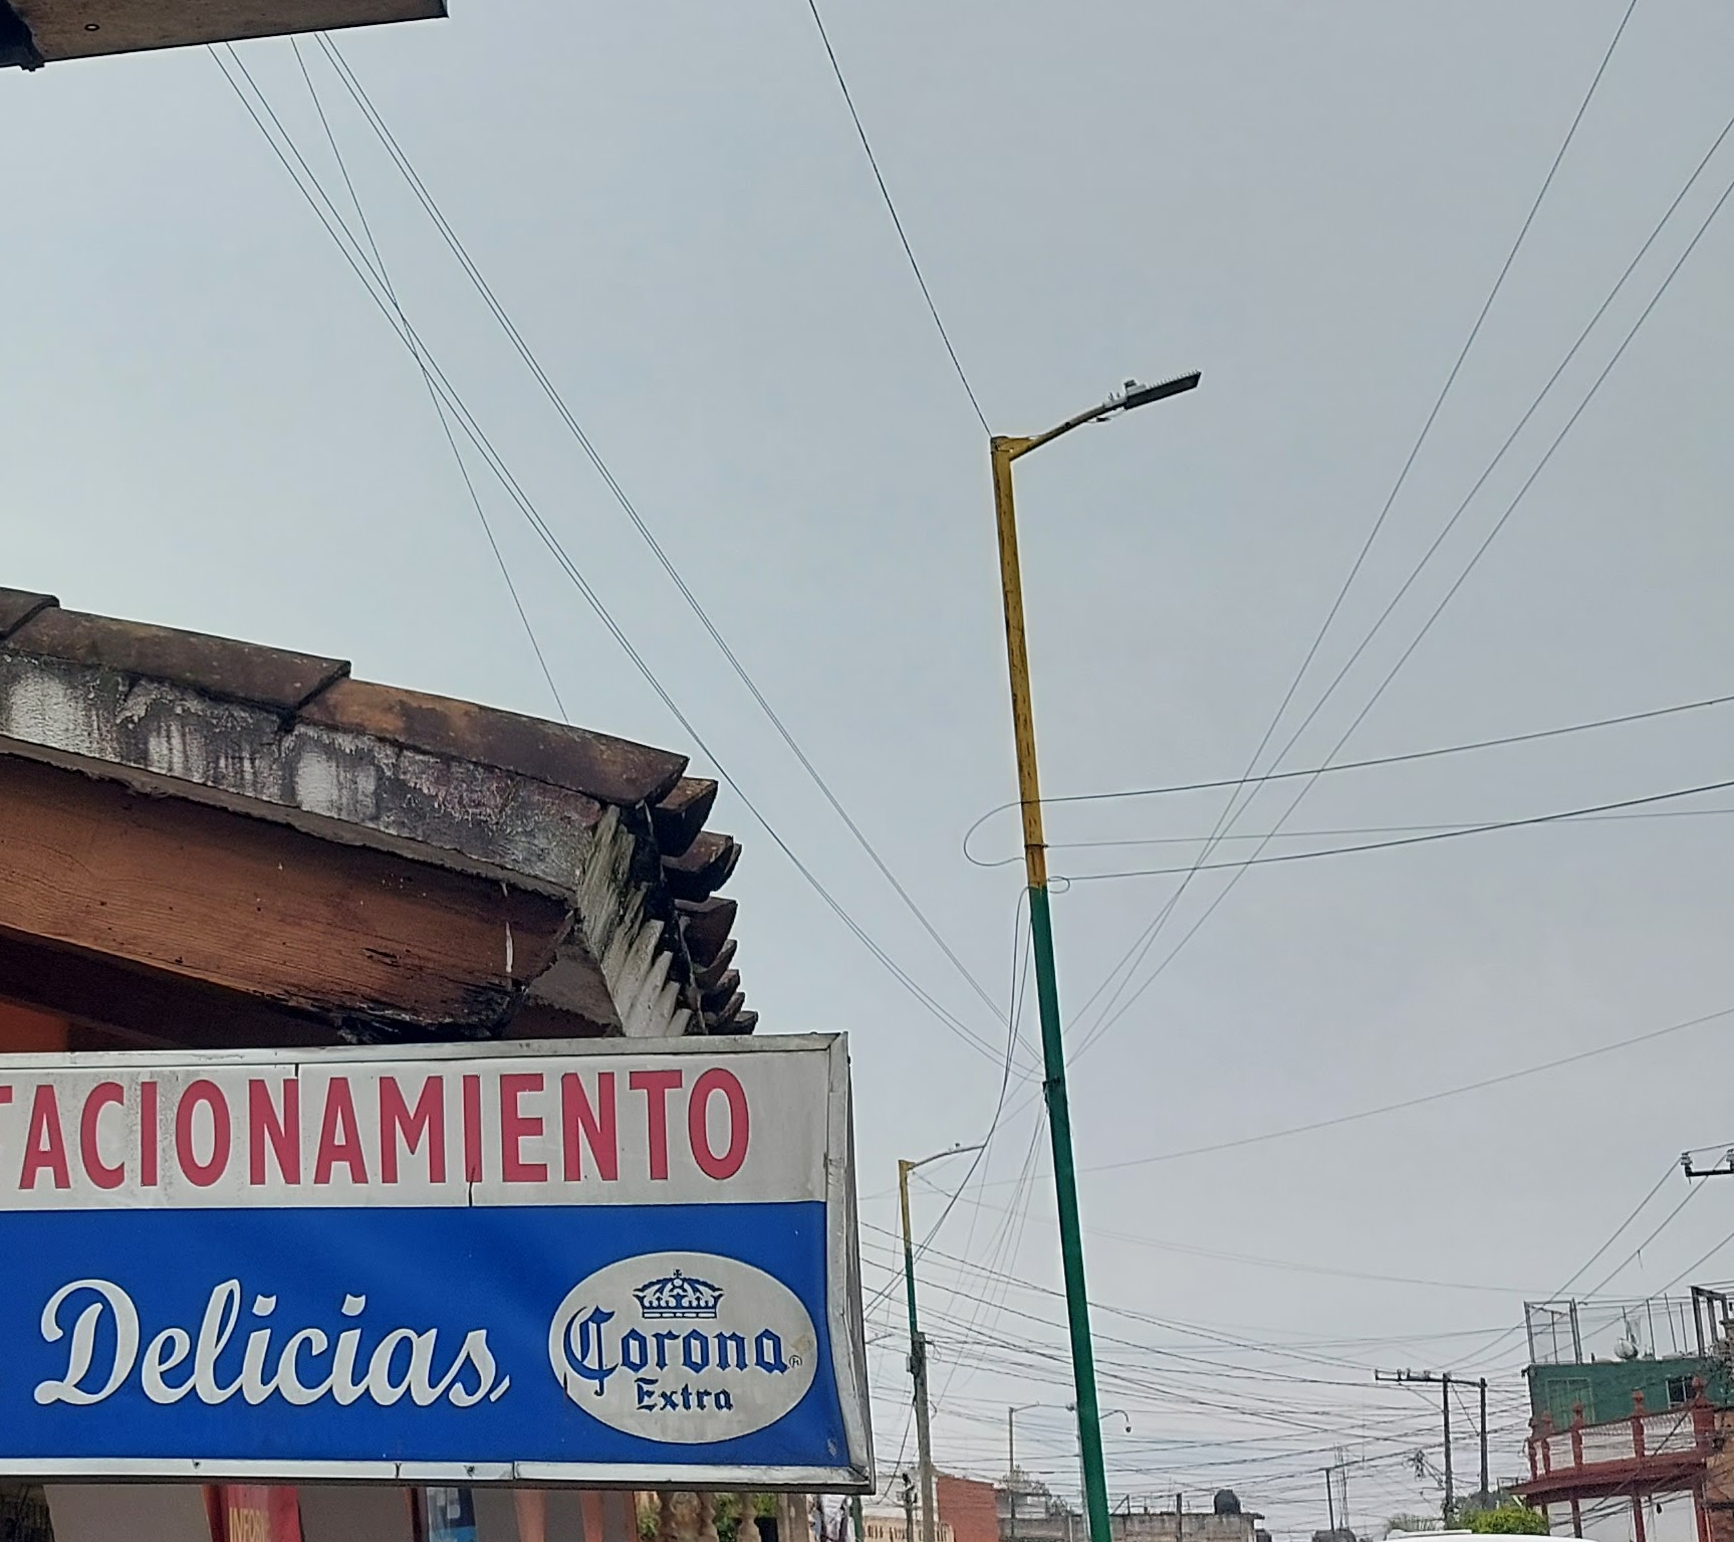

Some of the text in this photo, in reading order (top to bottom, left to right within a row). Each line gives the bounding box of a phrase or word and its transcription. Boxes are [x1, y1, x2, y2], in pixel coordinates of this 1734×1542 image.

[33, 1277, 512, 1409] Delicias
[563, 1304, 792, 1397] Corona
[633, 1377, 734, 1413] Extra
